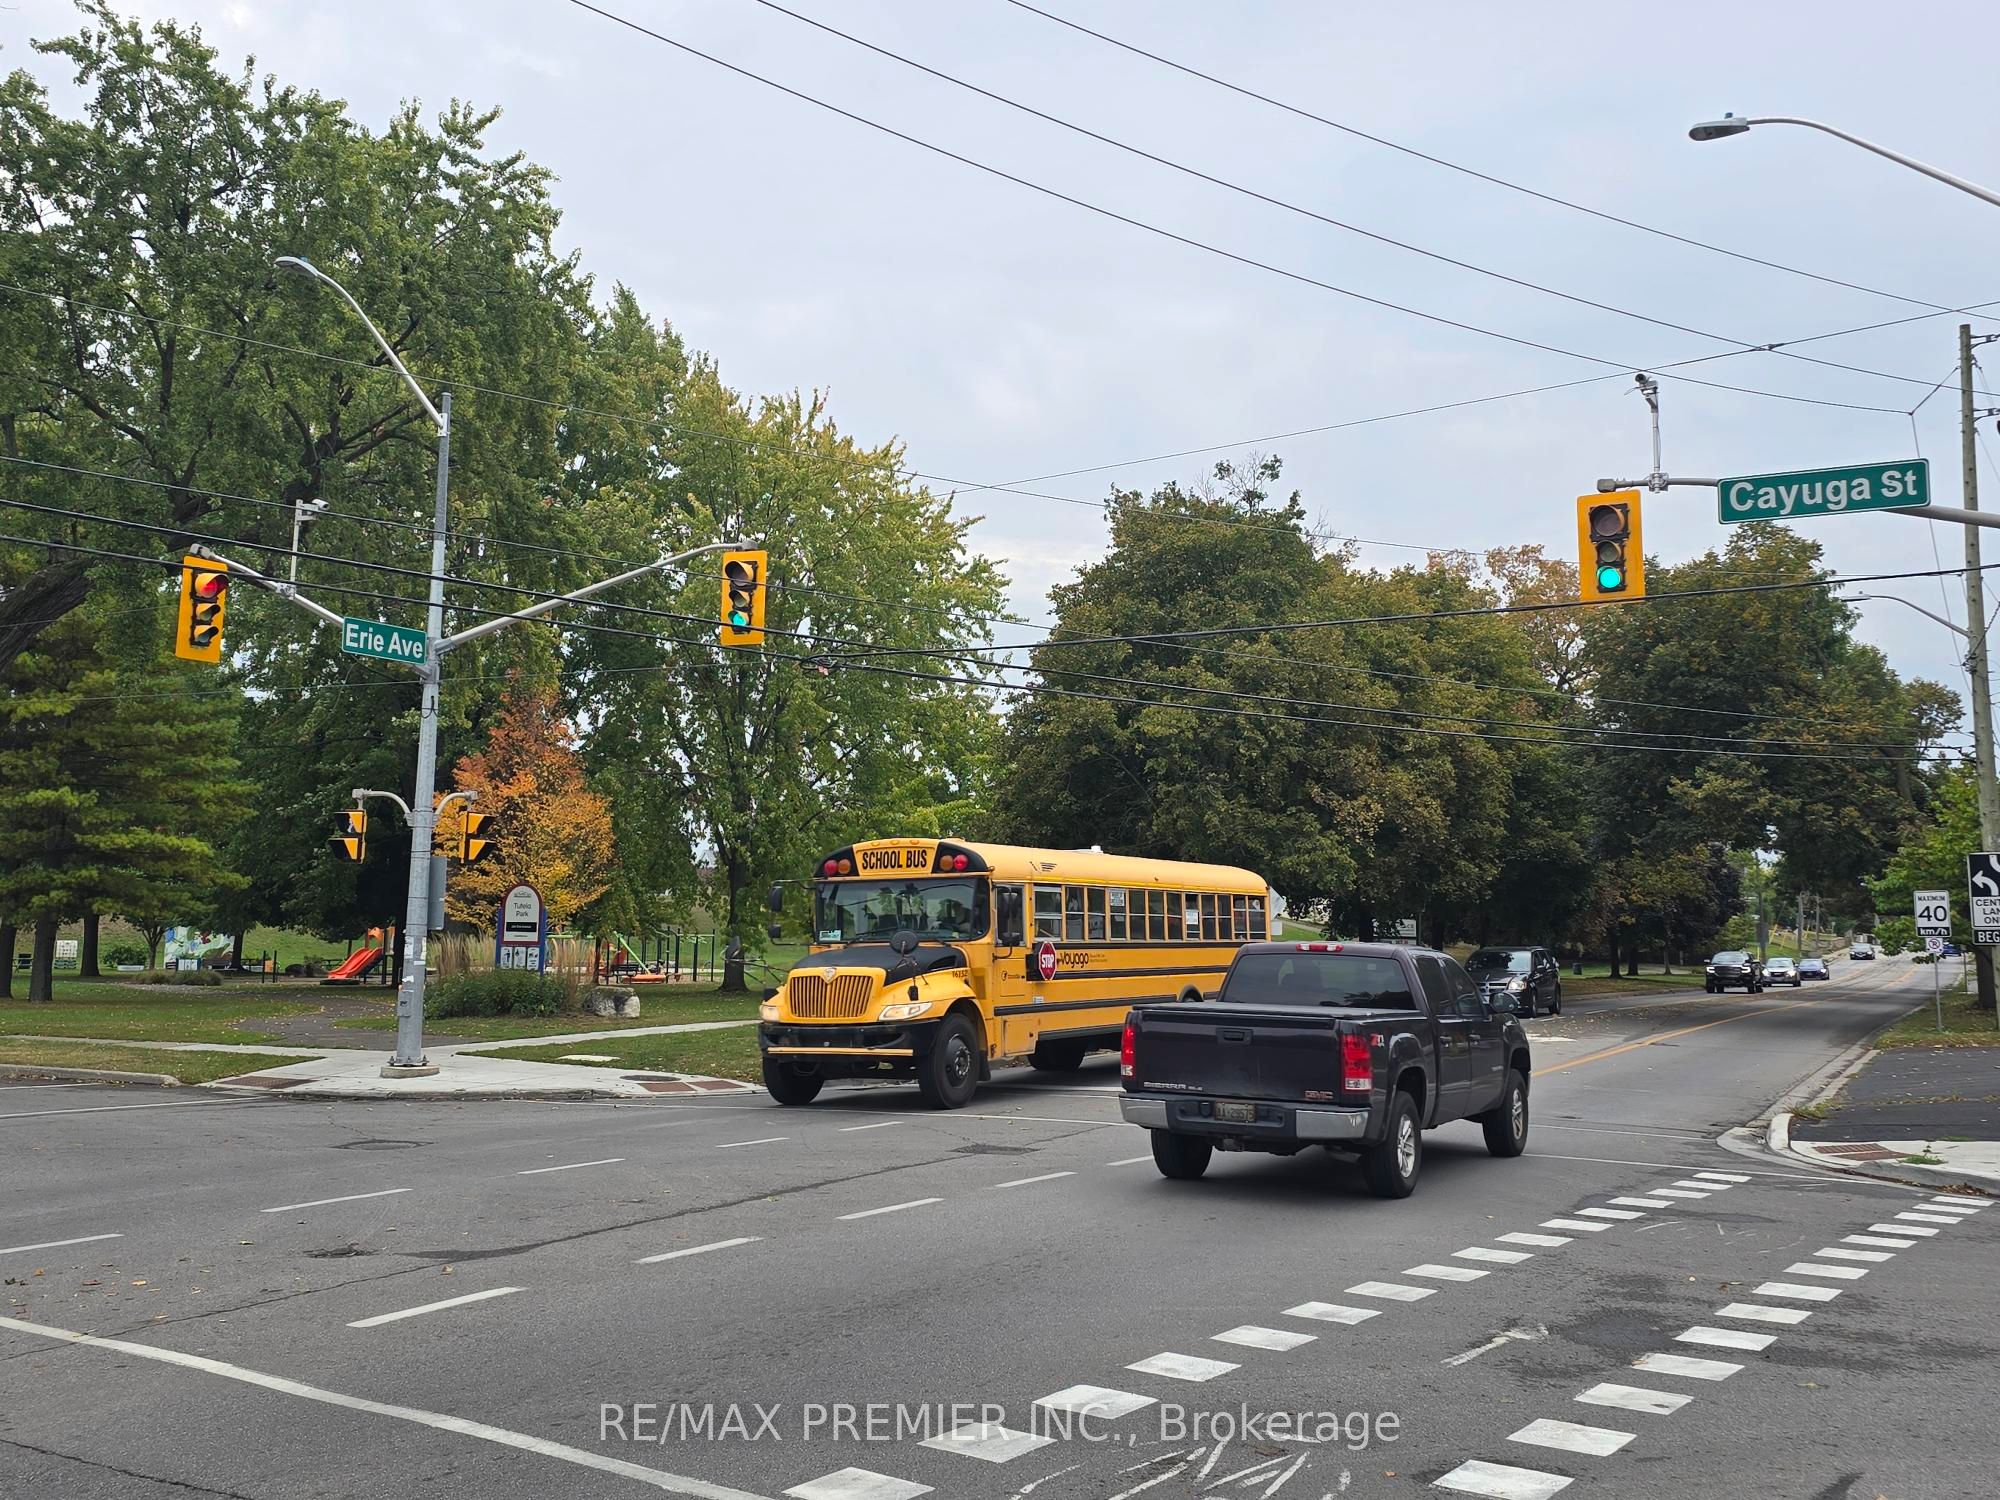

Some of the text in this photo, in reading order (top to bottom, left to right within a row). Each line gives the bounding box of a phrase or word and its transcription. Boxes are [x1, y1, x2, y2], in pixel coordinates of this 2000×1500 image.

[1729, 469, 1918, 515] Cayuga St
[345, 623, 423, 659] Erie Ave
[862, 849, 927, 870] SCHOOL BUS
[1918, 905, 1947, 921] 40
[1920, 928, 1948, 936] km/h
[1978, 931, 2000, 942] BEG
[1041, 953, 1054, 968] STOP
